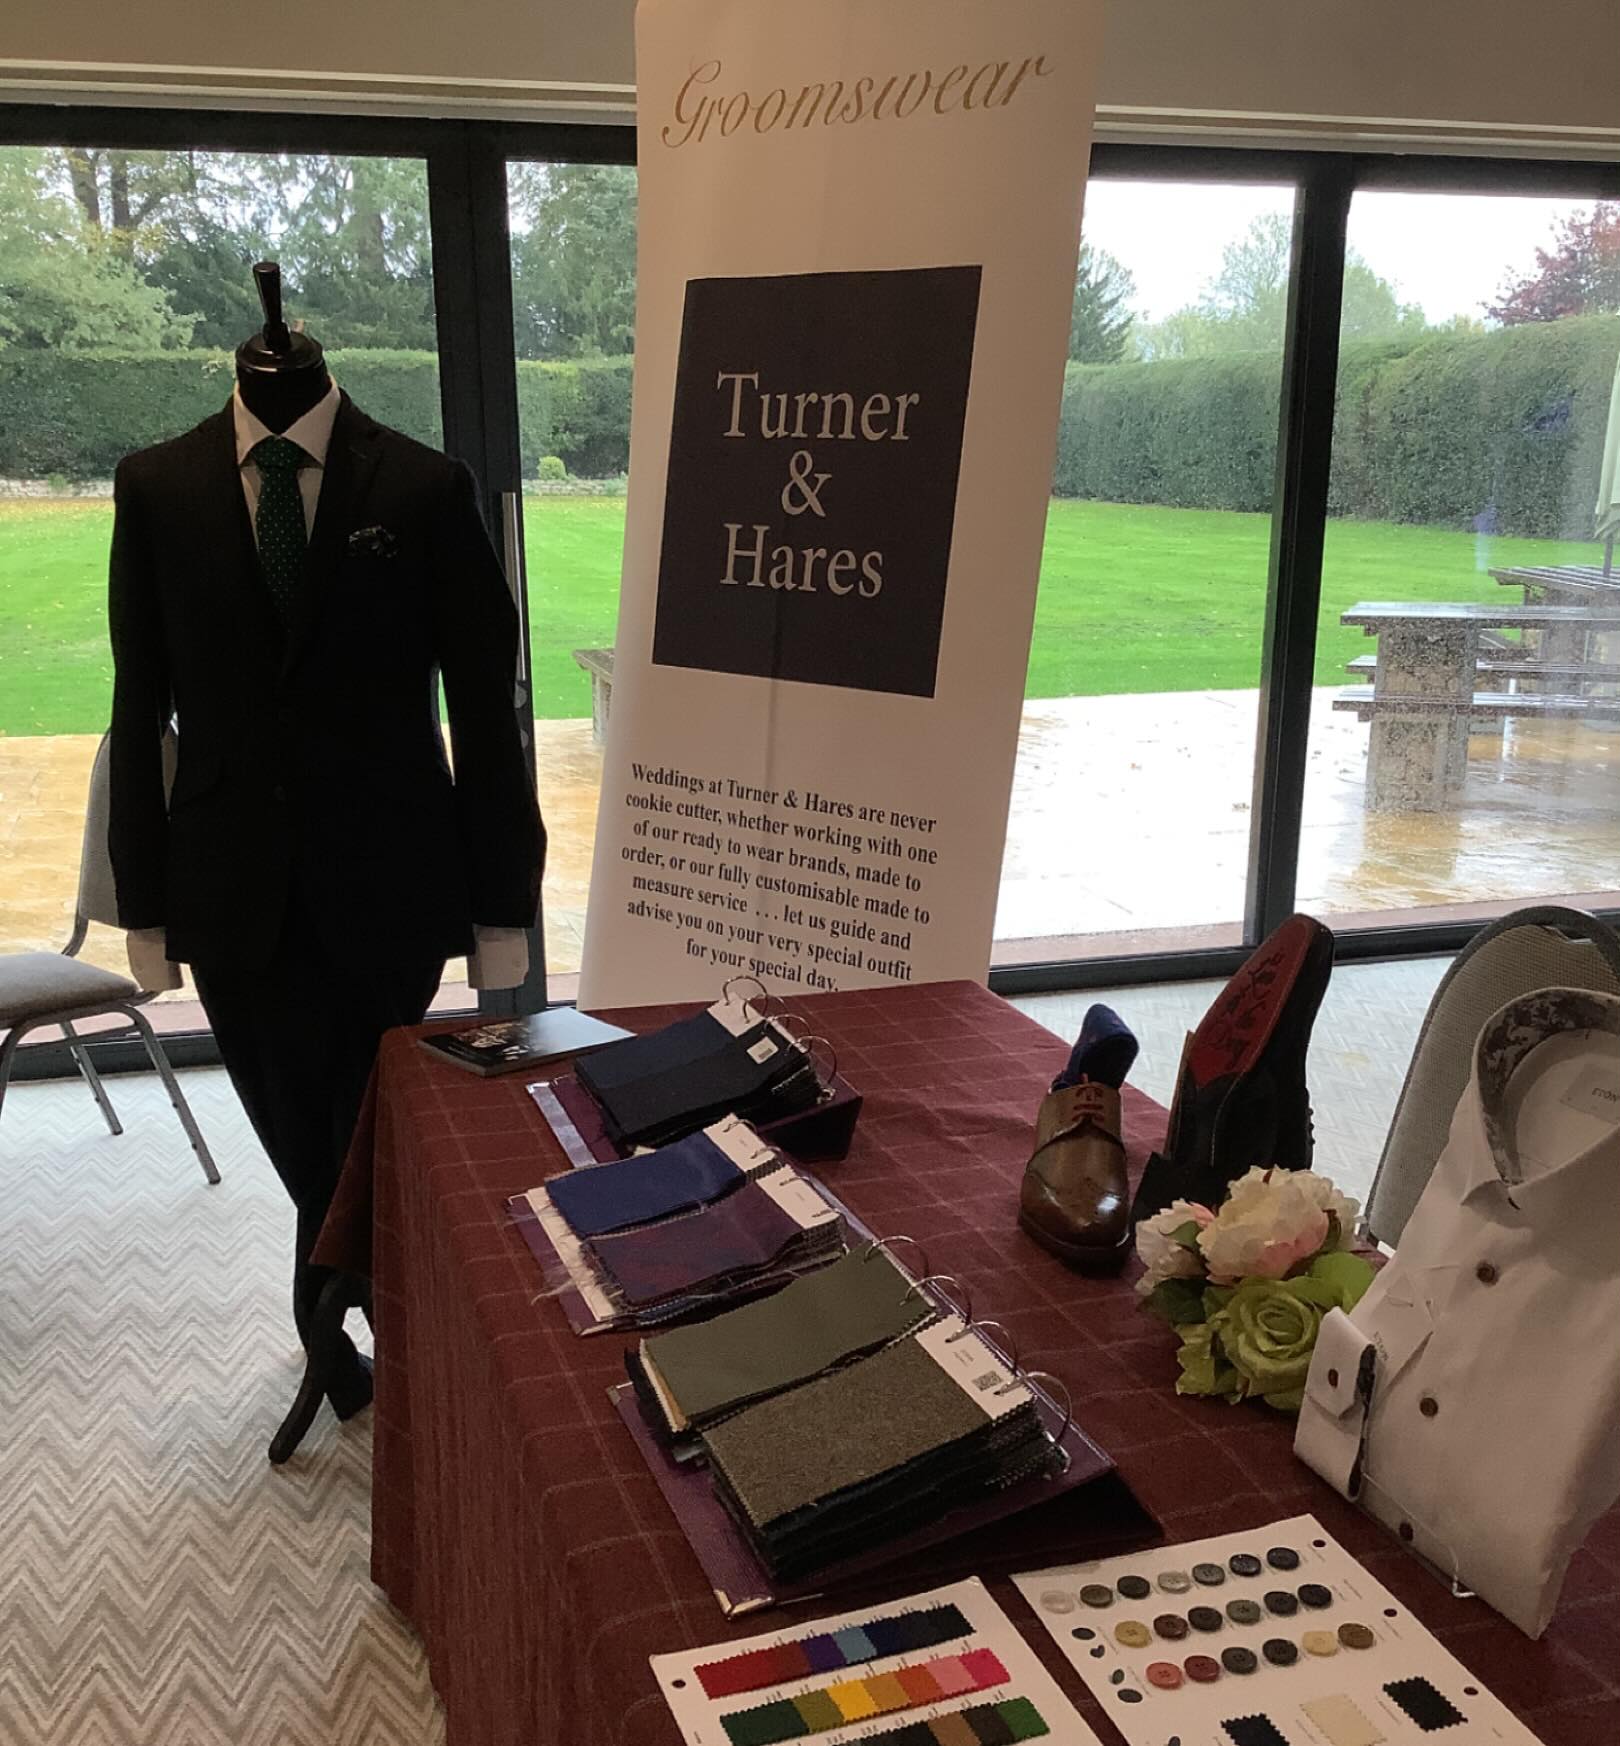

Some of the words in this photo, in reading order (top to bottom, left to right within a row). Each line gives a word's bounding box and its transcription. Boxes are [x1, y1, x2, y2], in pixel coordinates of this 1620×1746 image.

[661, 53, 1054, 148] Groomswear
[717, 371, 920, 441] Turner
[781, 450, 832, 517] &
[720, 523, 883, 598] Hares
[626, 792, 673, 813] cookie
[676, 801, 722, 825] cutter,
[727, 810, 789, 836] whether
[794, 825, 862, 854] working
[868, 836, 902, 857] with
[908, 845, 938, 865] one
[632, 763, 704, 795] Weddings
[708, 779, 723, 795] at
[727, 779, 779, 805] Turner
[783, 789, 798, 808] &
[804, 792, 854, 818] Hares
[858, 806, 885, 823] are
[890, 811, 937, 833] never
[621, 846, 665, 869] order,
[669, 856, 686, 871] or
[689, 861, 714, 877] our
[718, 863, 751, 889] fully
[755, 874, 859, 908] customisable
[864, 897, 909, 920] made
[914, 906, 930, 925] to
[633, 820, 650, 836] of
[652, 826, 679, 841] our
[683, 832, 723, 856] ready
[728, 837, 741, 855] to
[746, 843, 784, 864] wear
[789, 848, 850, 879] brands,
[856, 865, 900, 887] made
[905, 873, 921, 892] to
[627, 900, 673, 922] advise
[676, 911, 702, 929] you
[706, 919, 724, 936] on
[728, 925, 764, 945] your
[767, 934, 803, 957] very
[807, 943, 863, 969] special
[867, 957, 912, 981] outfit
[633, 876, 694, 900] measure
[697, 891, 748, 913] service
[783, 905, 803, 926] let
[809, 914, 826, 930] us
[830, 919, 876, 942] guide
[880, 931, 911, 951] and
[686, 938, 707, 958] for
[710, 948, 745, 968] your
[748, 957, 802, 982] special
[806, 968, 839, 992] day.
